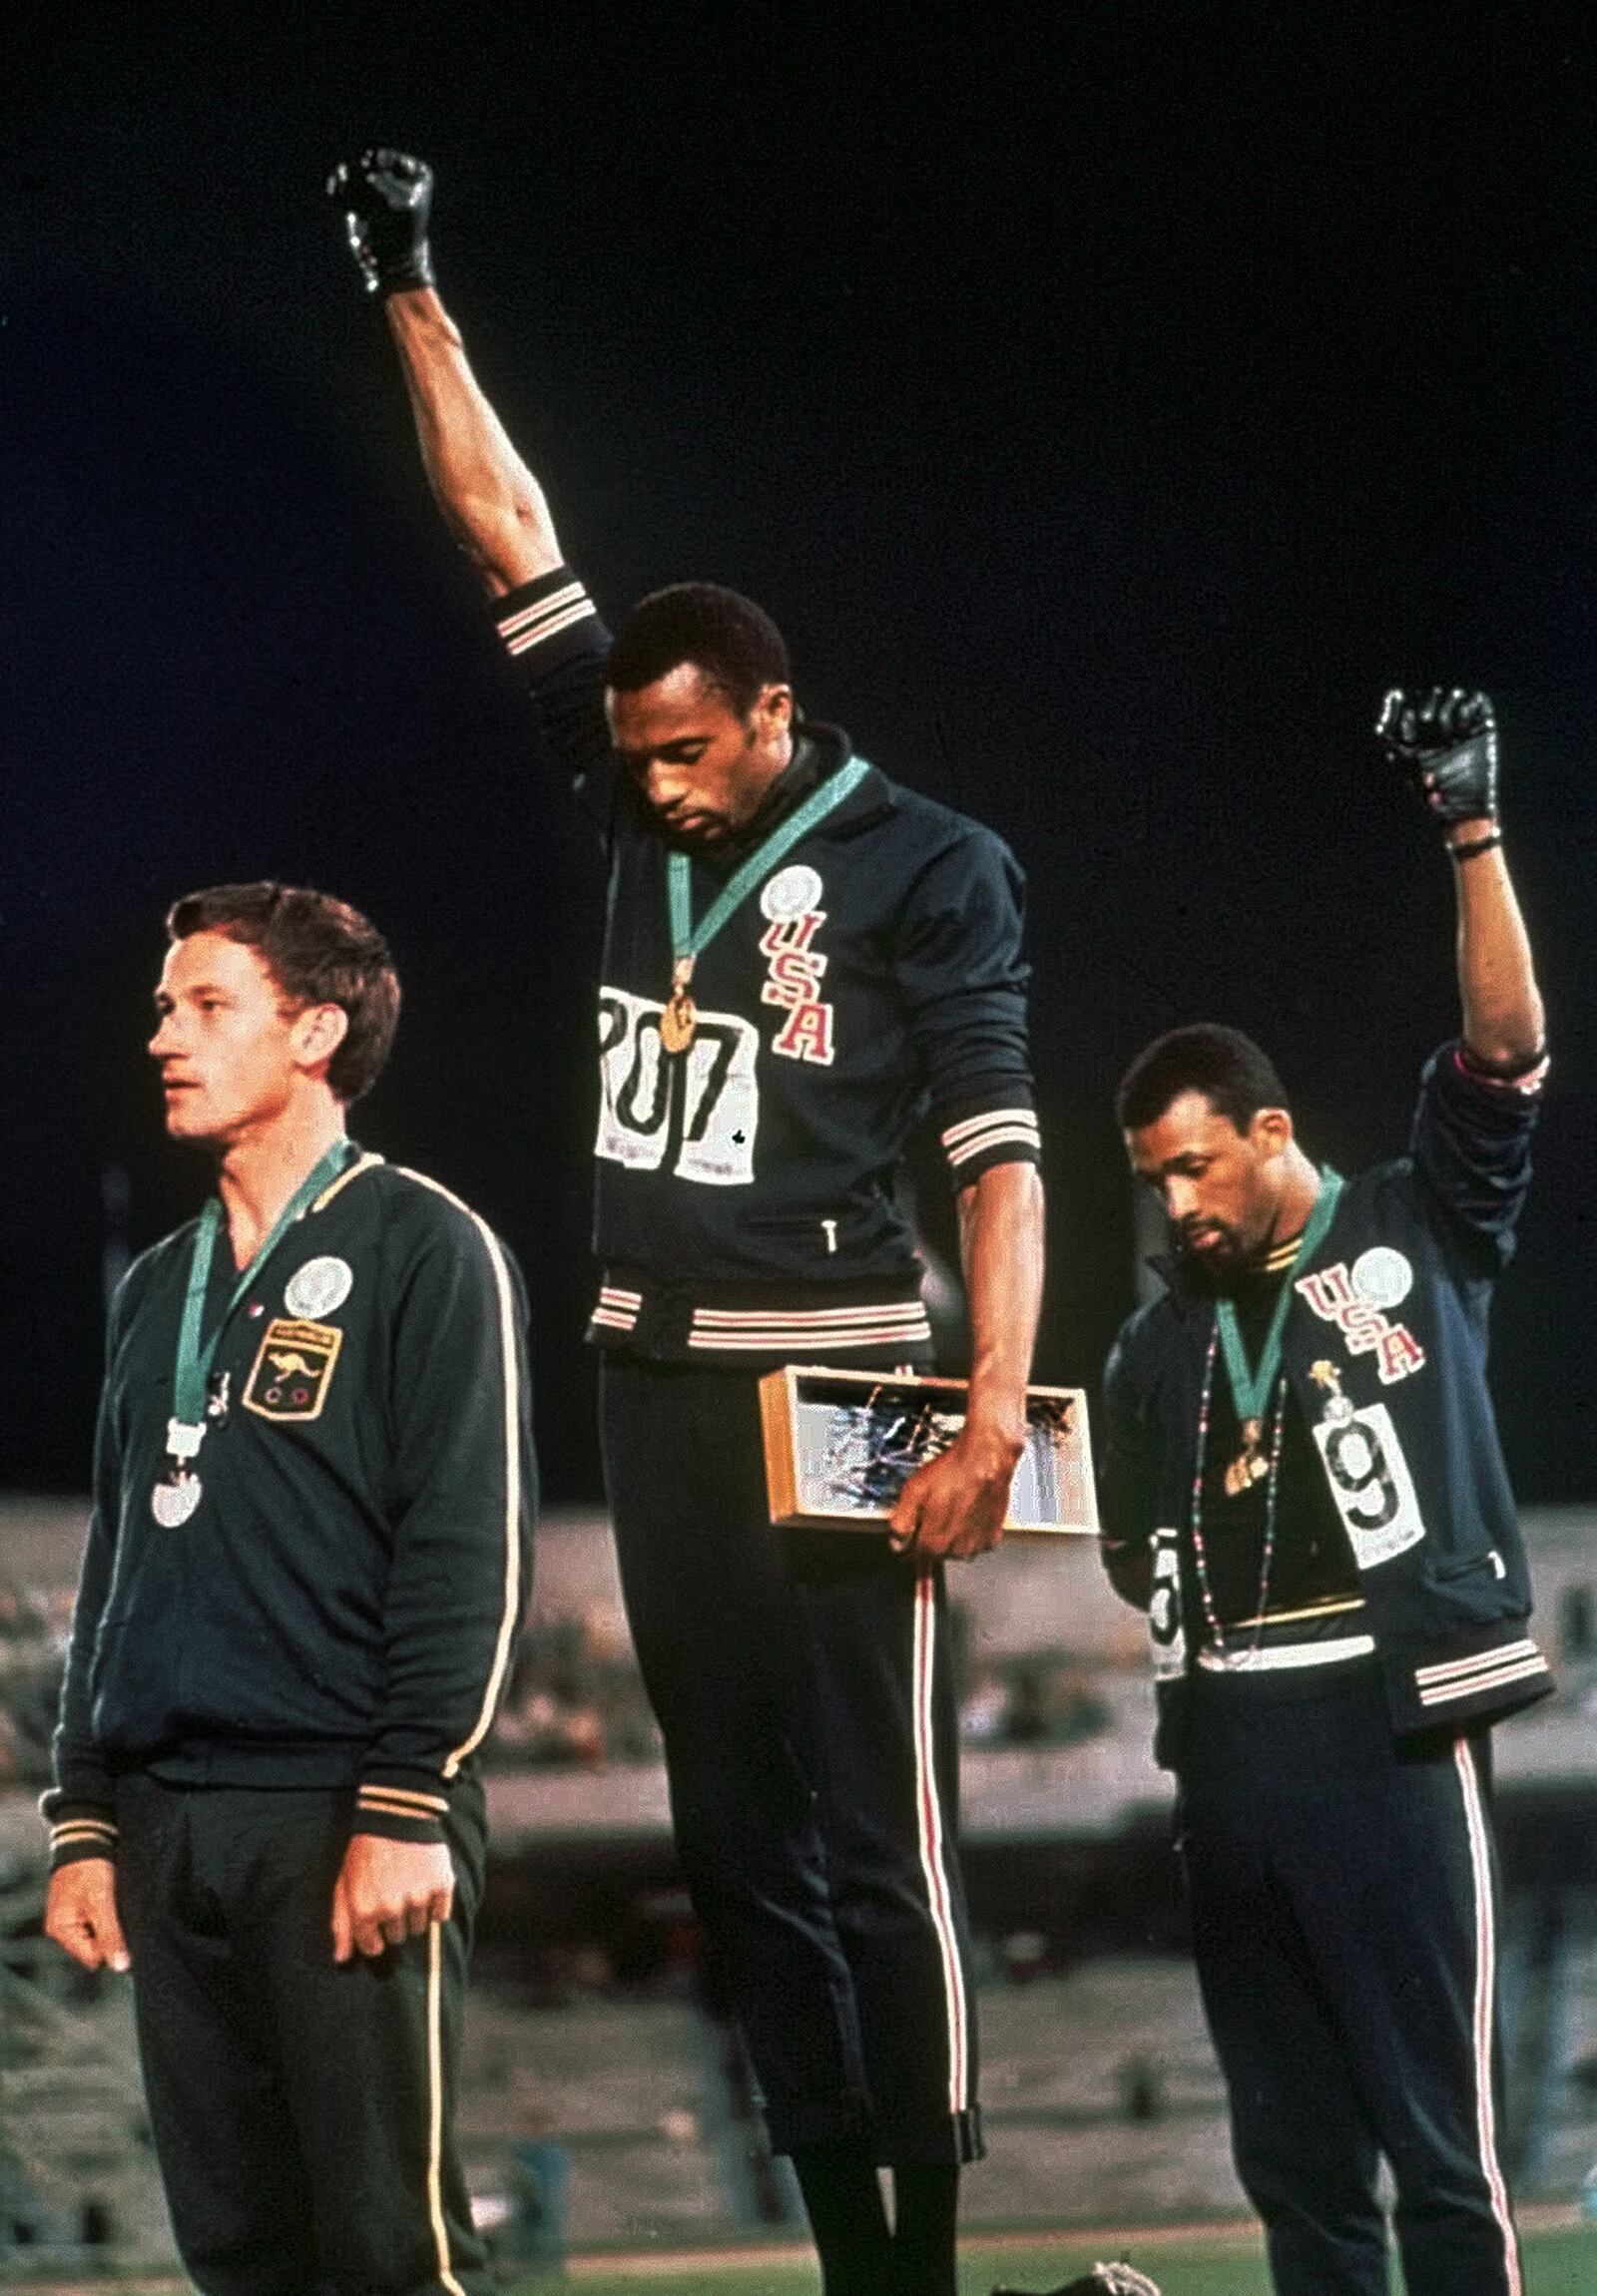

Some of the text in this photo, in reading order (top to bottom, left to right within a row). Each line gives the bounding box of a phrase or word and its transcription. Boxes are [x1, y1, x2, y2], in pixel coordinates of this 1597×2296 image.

[759, 910, 834, 1067] USA
[1295, 1262, 1425, 1385] USA
[1325, 1421, 1399, 1531] 9
